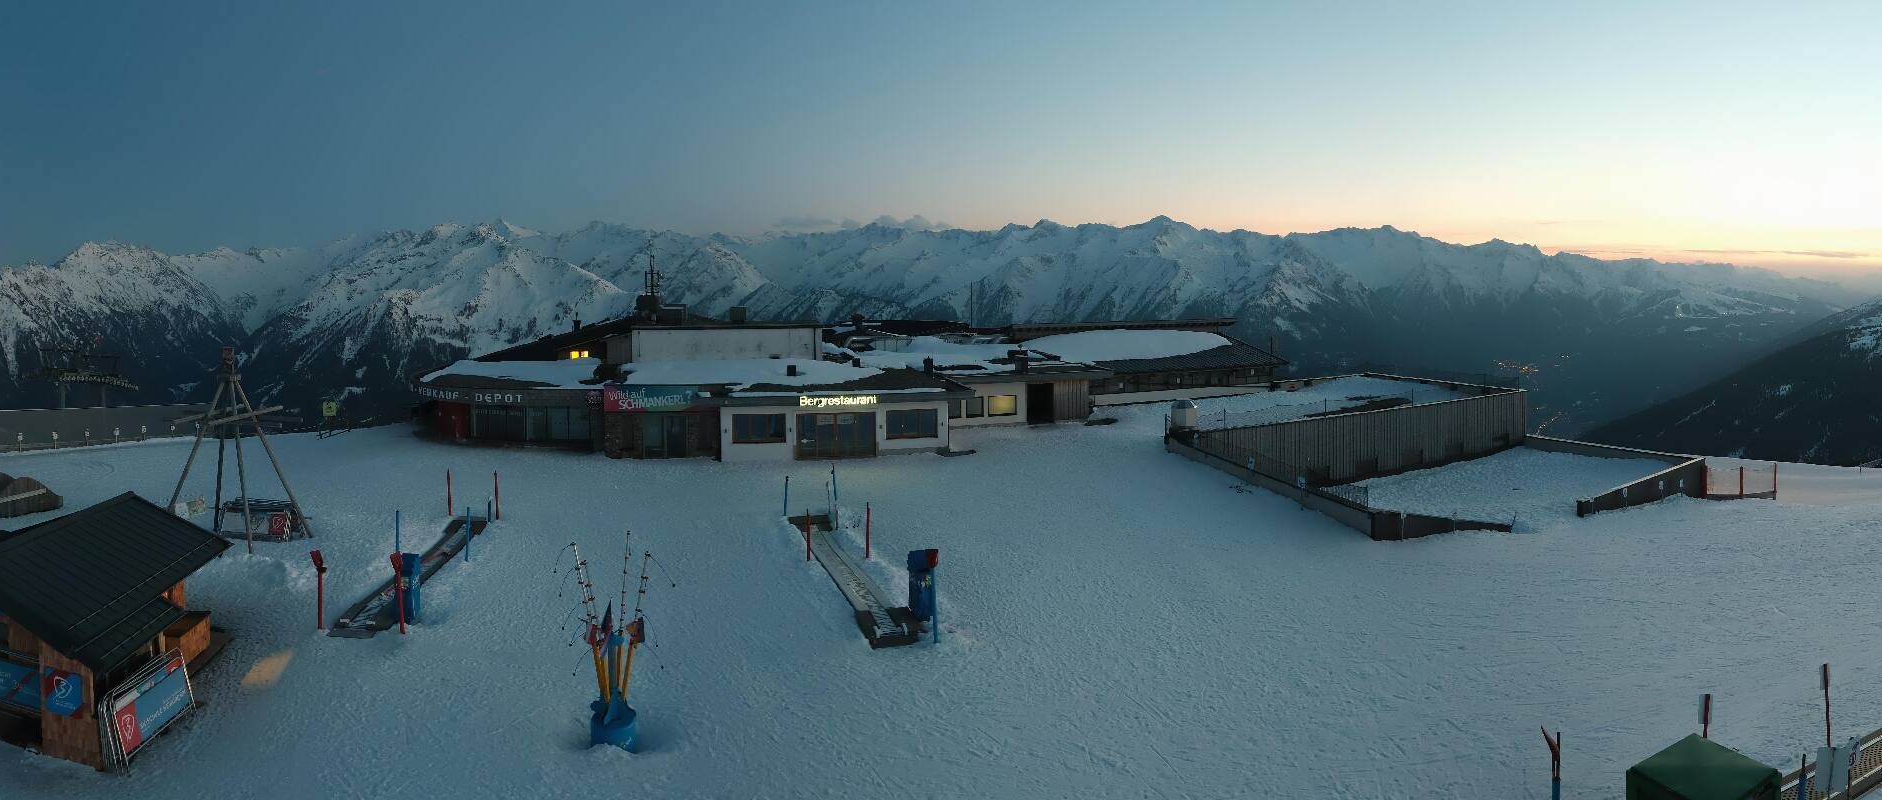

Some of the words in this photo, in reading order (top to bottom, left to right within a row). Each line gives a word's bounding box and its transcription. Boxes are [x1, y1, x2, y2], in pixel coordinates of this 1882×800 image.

[418, 386, 459, 400] VERKAUF
[475, 393, 523, 403] DEPOT
[608, 389, 629, 401] Wild
[630, 387, 646, 399] auf
[799, 395, 877, 407] Bergrestaurant
